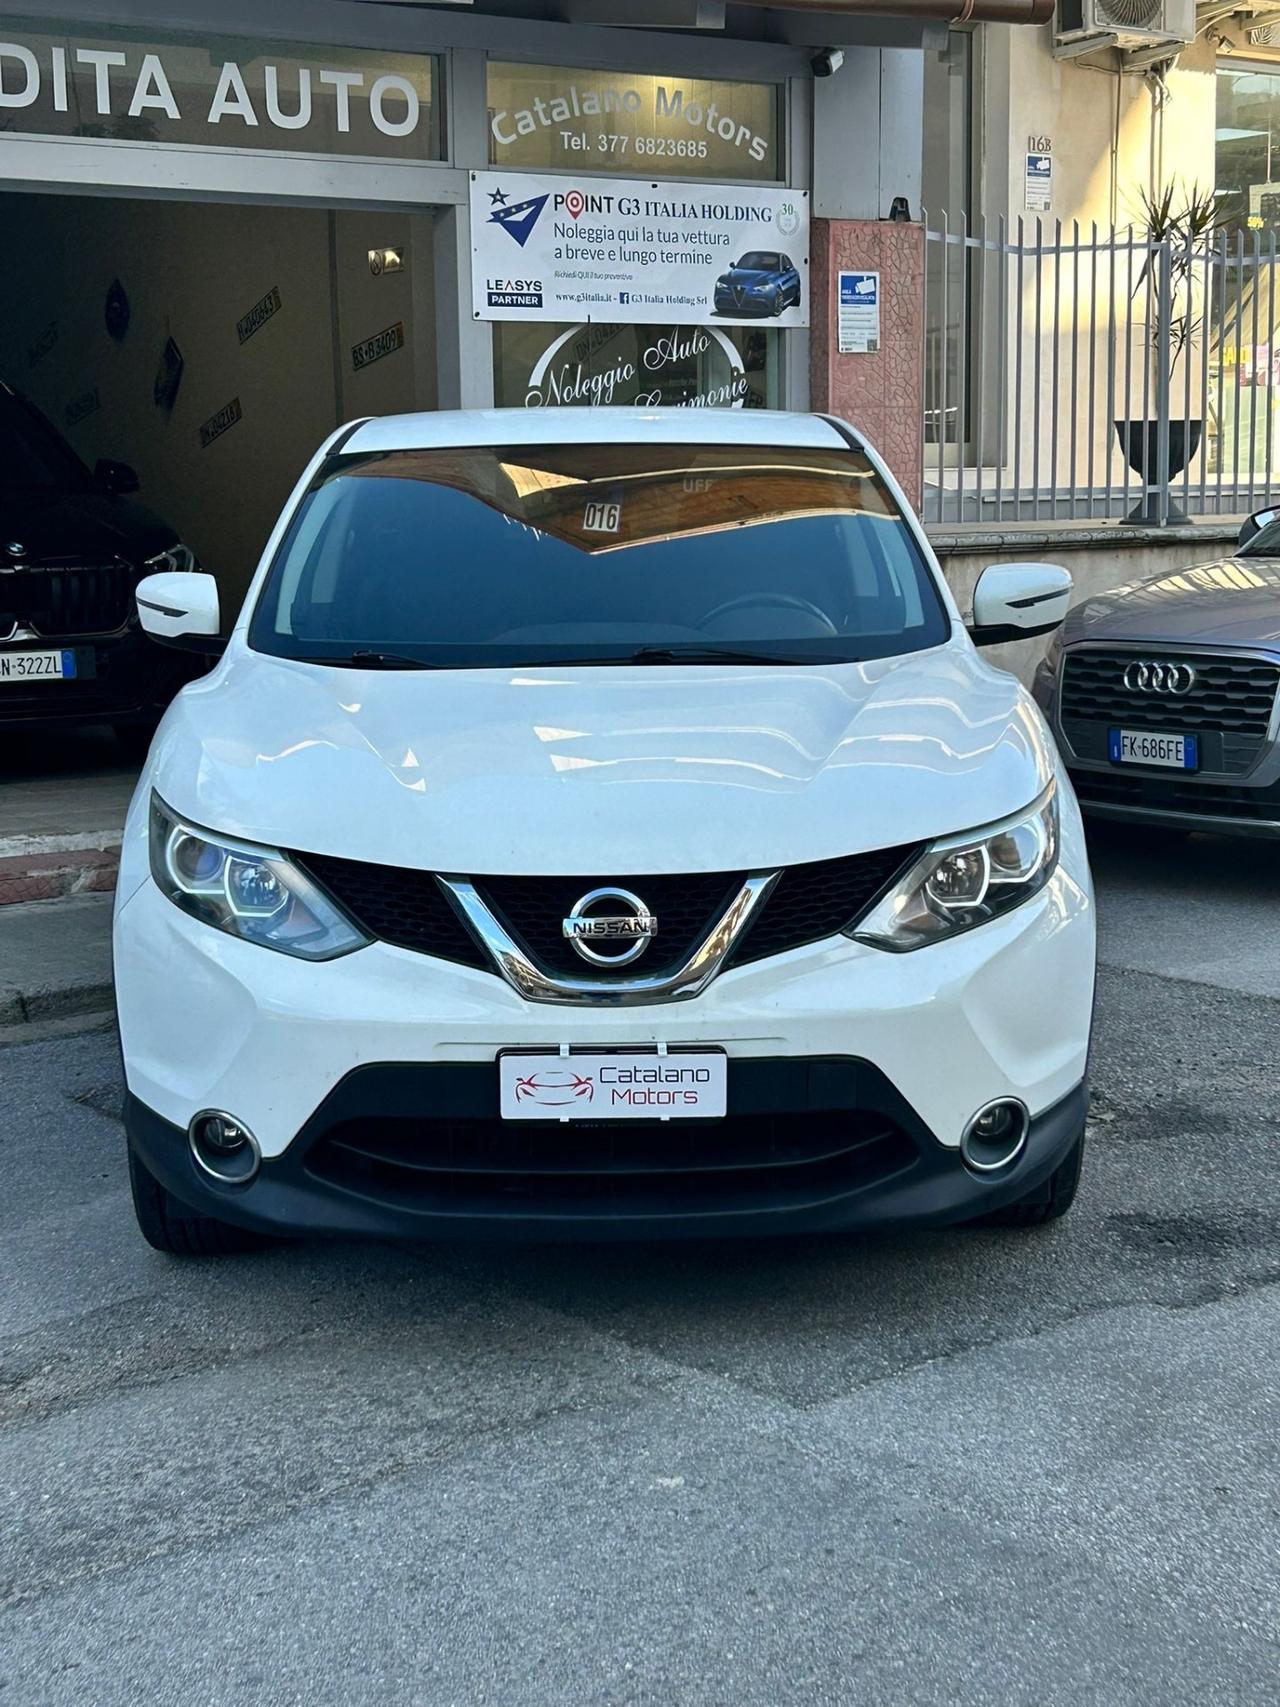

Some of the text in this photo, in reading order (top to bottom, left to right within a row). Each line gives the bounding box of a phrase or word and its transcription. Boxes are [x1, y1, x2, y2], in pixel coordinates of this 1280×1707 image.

[0, 42, 420, 137] DITA AUTO
[491, 86, 769, 162] Catalano Motors
[559, 131, 708, 158] Tel. 377 6823685
[554, 190, 773, 222] POINT G3 ITALIA HOLDING
[781, 203, 794, 216] 30
[554, 222, 730, 246] Noleggia qui la tua vettura
[554, 243, 713, 265] a breve e lungo termine
[486, 279, 543, 292] LEASYS
[491, 295, 539, 305] PARTNER
[644, 295, 664, 303] Italia
[525, 326, 710, 408] Noleggio Auto
[585, 503, 618, 530] 016
[573, 921, 650, 935] NISSAN
[600, 1065, 710, 1083] Catalano
[611, 1087, 698, 1106] Motors
